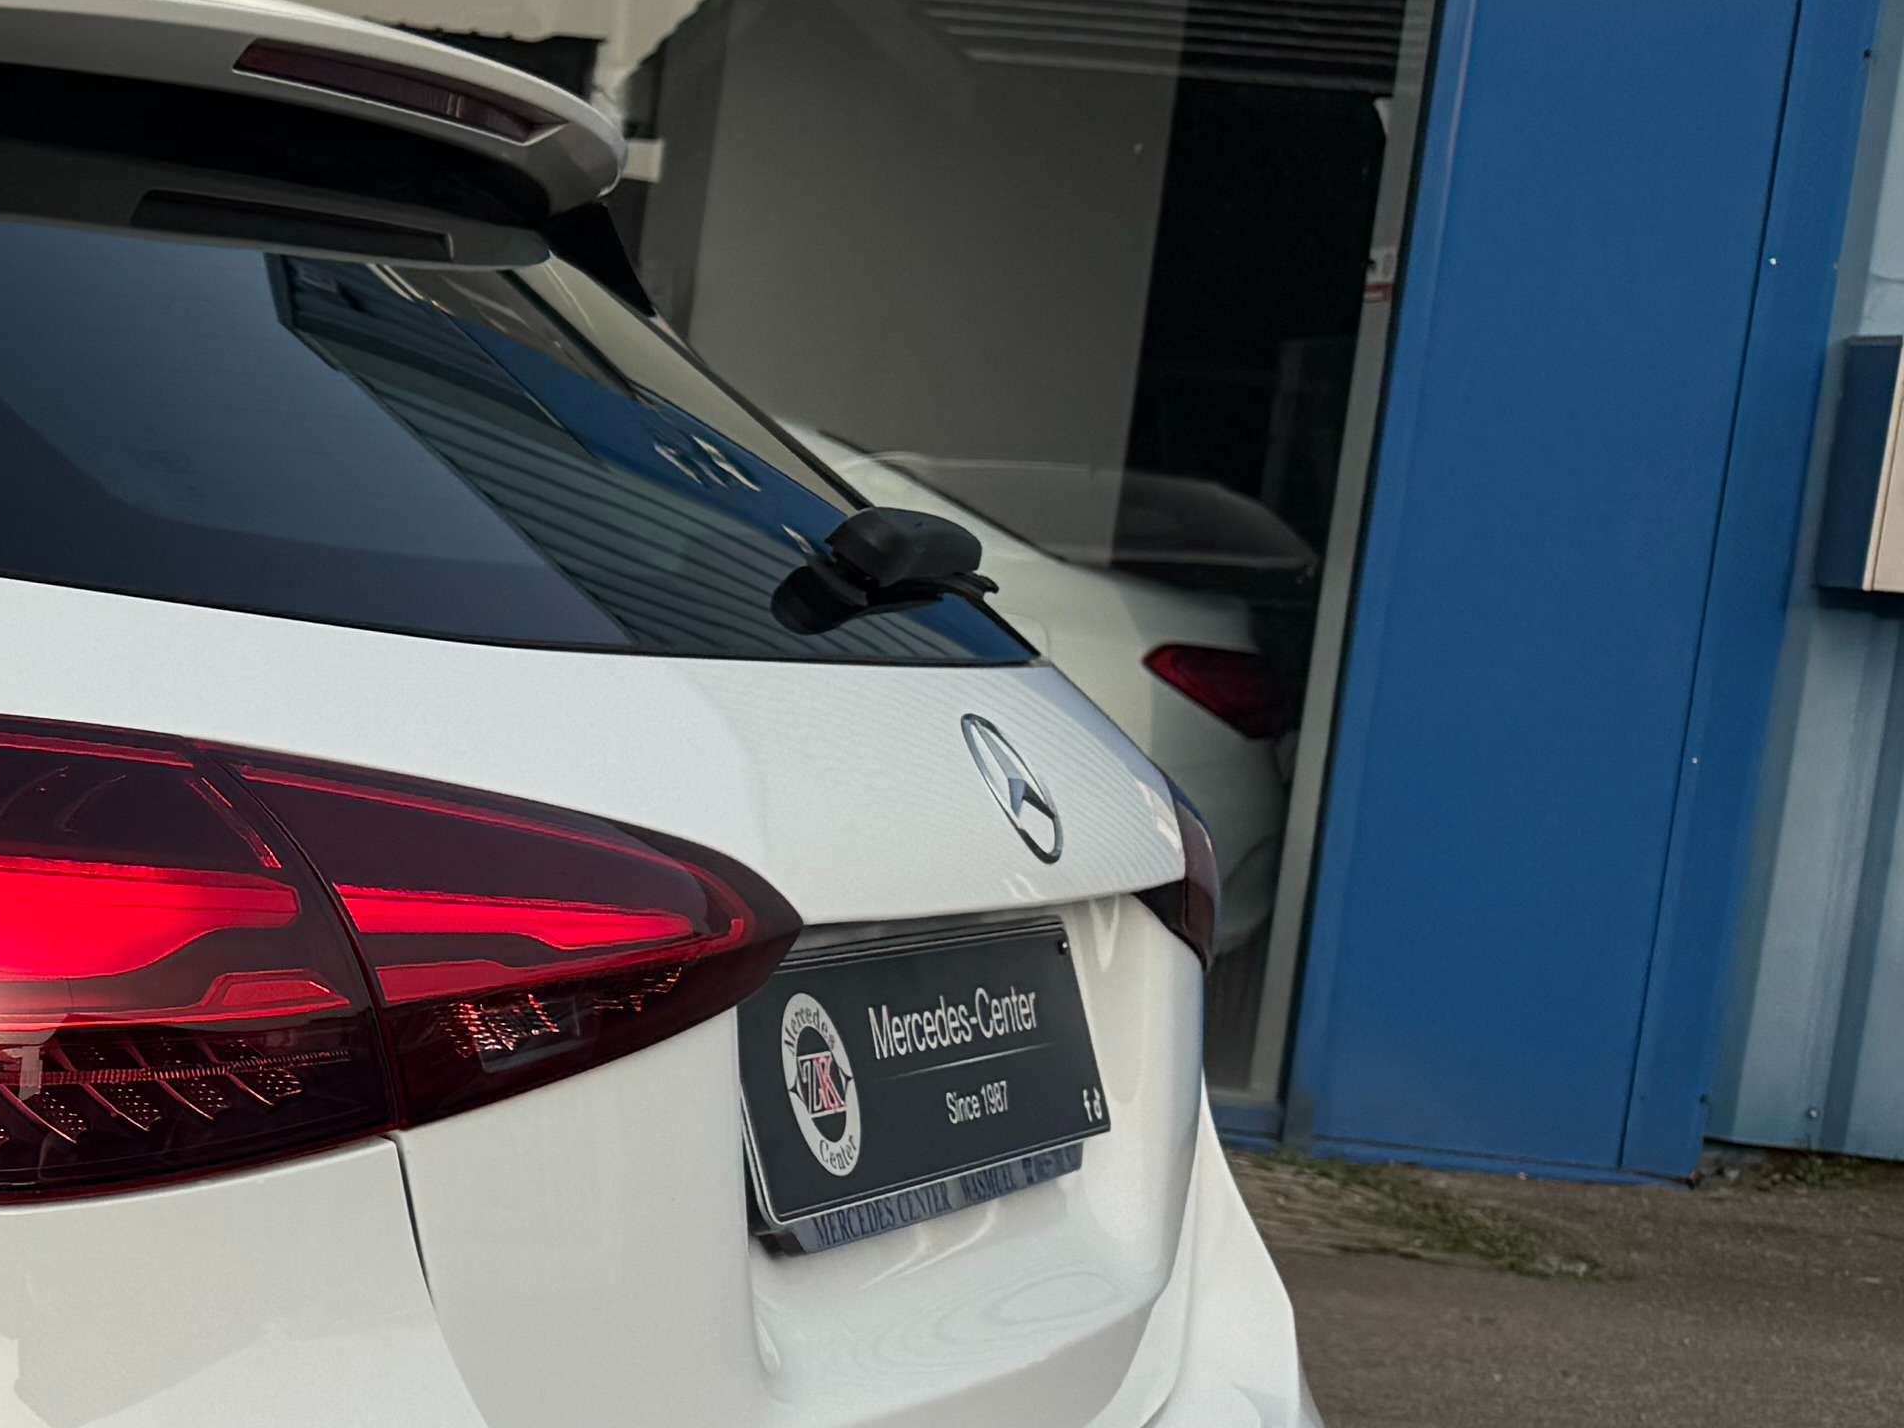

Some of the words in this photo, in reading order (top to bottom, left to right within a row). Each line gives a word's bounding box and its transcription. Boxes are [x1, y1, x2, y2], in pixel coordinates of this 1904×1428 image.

[783, 1007, 836, 1054] Mercedes
[868, 986, 1038, 1060] Mercedes-Center
[945, 1091, 981, 1124] Since
[980, 1080, 1009, 1116] 1987
[818, 1134, 858, 1170] Center
[812, 1200, 894, 1249] MERCEDES
[896, 1180, 952, 1224] CENTER
